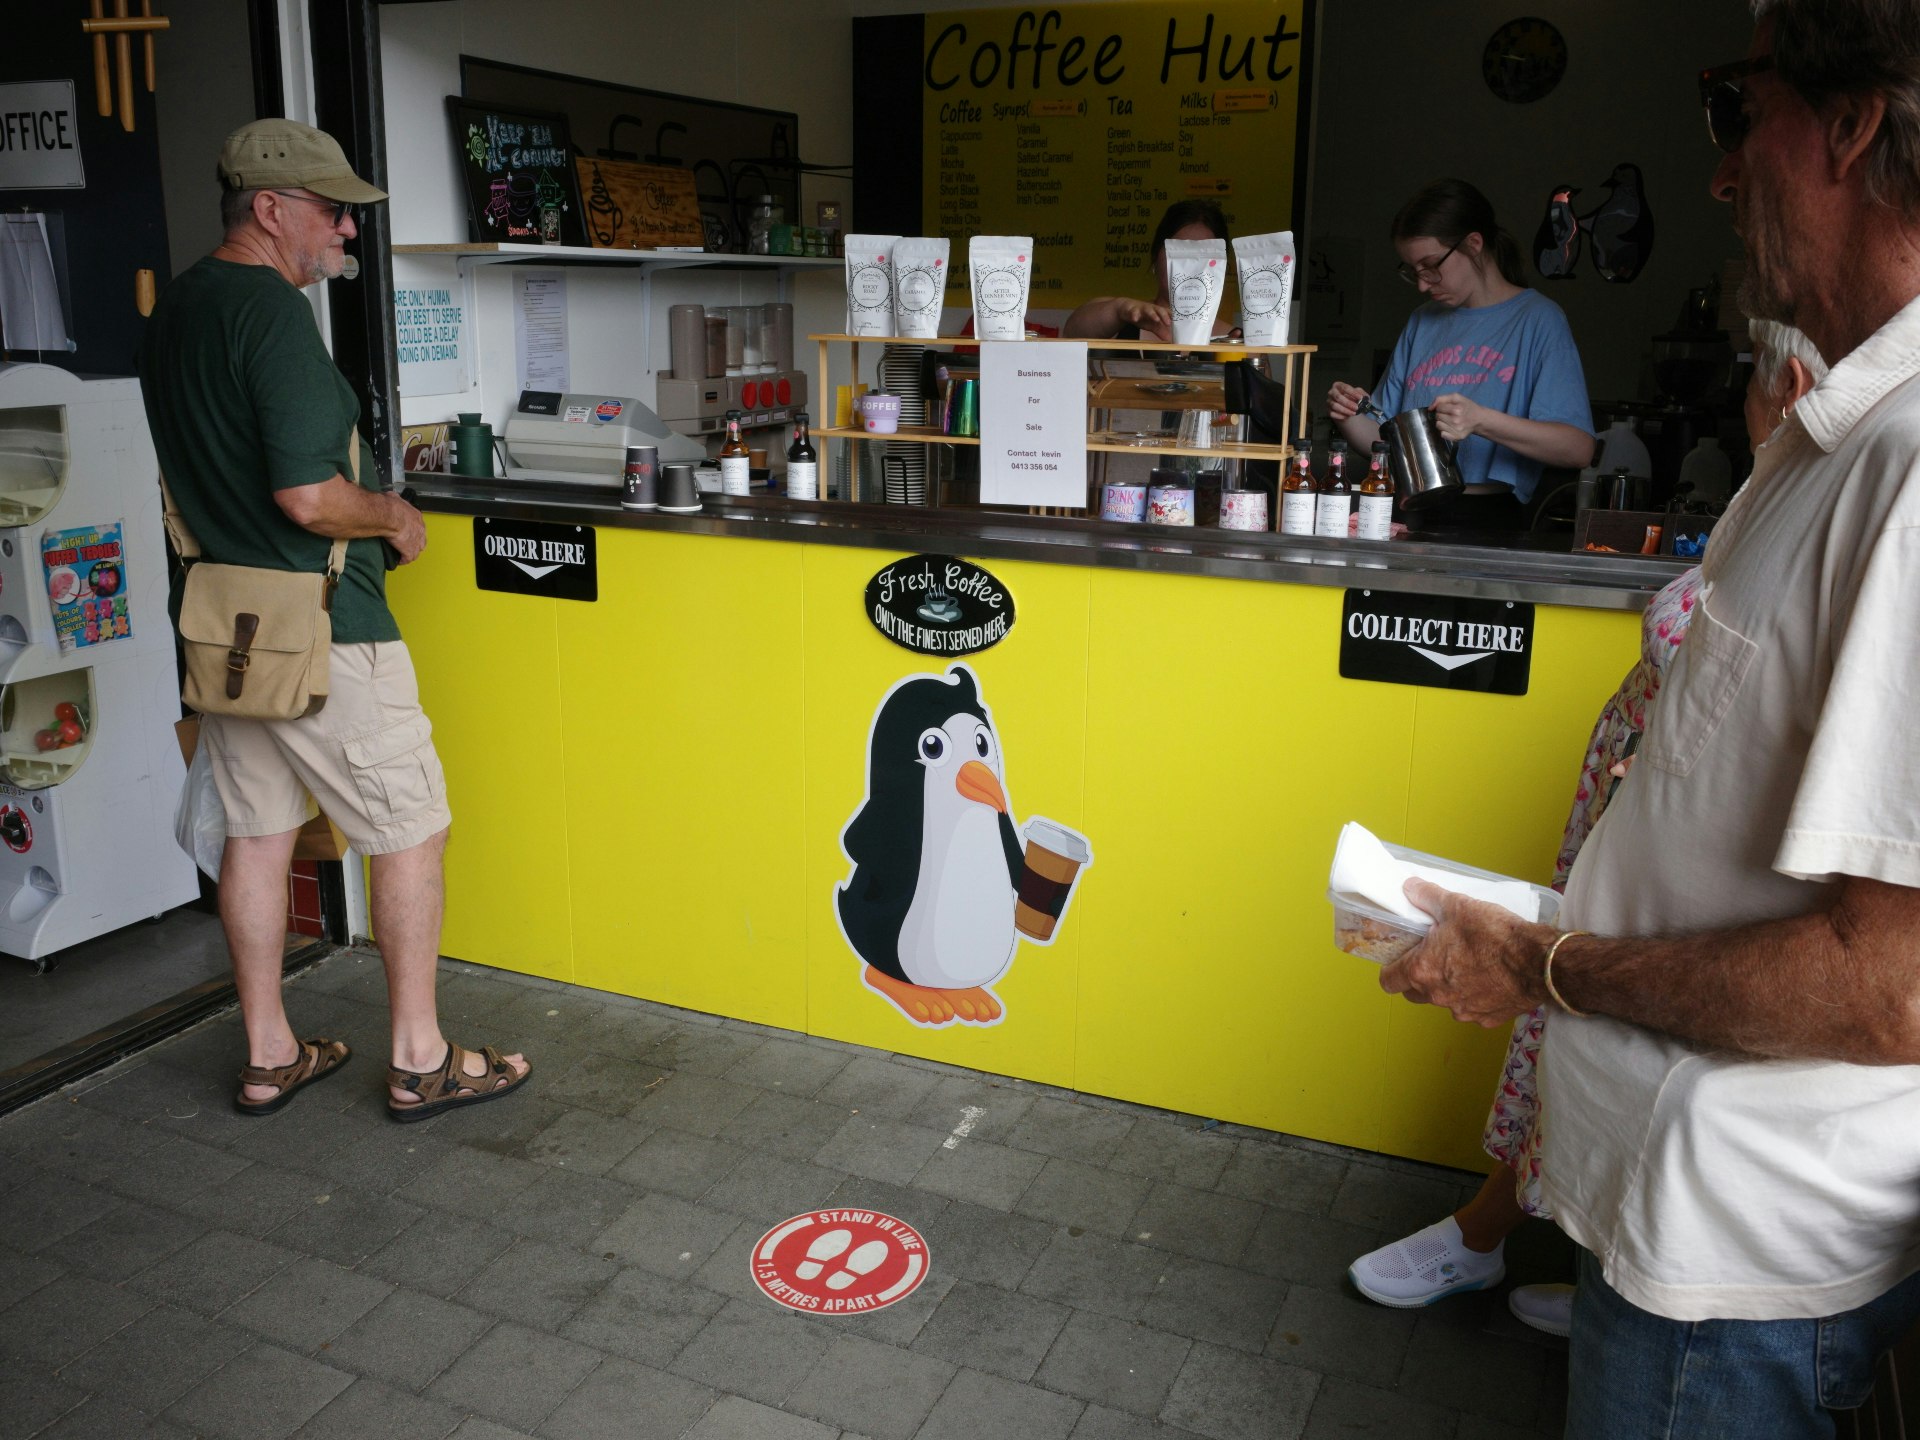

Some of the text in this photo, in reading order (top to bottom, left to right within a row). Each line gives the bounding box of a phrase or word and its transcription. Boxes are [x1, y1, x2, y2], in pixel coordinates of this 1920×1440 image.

[925, 10, 1300, 91] Coffee Hut
[1108, 96, 1133, 115] Tea
[1180, 91, 1208, 109] Milks
[939, 100, 982, 124] Coffee
[1179, 112, 1231, 126] Lactose Free
[1016, 123, 1041, 135] Vanilla
[1107, 127, 1132, 139] Green
[1016, 137, 1048, 149] Caramel
[1178, 131, 1194, 143] Soy
[1107, 140, 1174, 154] English Breakfast
[1178, 145, 1193, 156] Oat
[940, 158, 965, 169] Mocha
[1016, 152, 1074, 164] Salted Caramel
[1107, 158, 1152, 170] Peppermint
[1016, 167, 1050, 178] Hazelnut
[1179, 161, 1209, 174] Almond
[1016, 180, 1062, 192] Butterscotch
[1107, 173, 1143, 187] Earl Grey
[939, 184, 980, 196] Short Black
[1106, 189, 1132, 201] Vanilla
[1154, 188, 1168, 201] Tea
[939, 198, 978, 212] Long Black
[1016, 193, 1059, 206] Irish Cream
[1107, 205, 1151, 217] Decaf Tea
[939, 214, 964, 225] Vanilla
[1106, 223, 1125, 236] Large
[1104, 242, 1130, 253] Medium
[1103, 257, 1121, 268] Small
[394, 289, 451, 307] ARE ONLY HUMAN
[397, 307, 462, 325] OUR BEST TO SERVE
[399, 325, 459, 344] COULD BE A DELAY
[396, 344, 458, 363] NDING ON DEMAND
[1017, 369, 1052, 378] Business
[862, 401, 897, 411] COFFEE
[1028, 396, 1041, 404] For
[1025, 423, 1043, 431] Sale
[402, 425, 450, 471] Coff
[1007, 449, 1061, 458] Contact kevin
[1011, 462, 1029, 470] 0413
[1044, 463, 1058, 471] 054
[1106, 488, 1136, 505] PINK
[60, 533, 100, 549] LIGHT UP
[44, 541, 121, 567] PUFFER TEDDIES
[484, 534, 586, 565] ORDER HERE
[878, 561, 1003, 609] Fresh Coffee
[71, 606, 80, 615] OF
[875, 603, 1007, 651] ONLY THE FINEST SERVED HERE
[1348, 611, 1525, 653] COLLECT HERE
[819, 1211, 922, 1251] STAND IN LINE
[757, 1262, 878, 1311] 1.5 METRES APART
